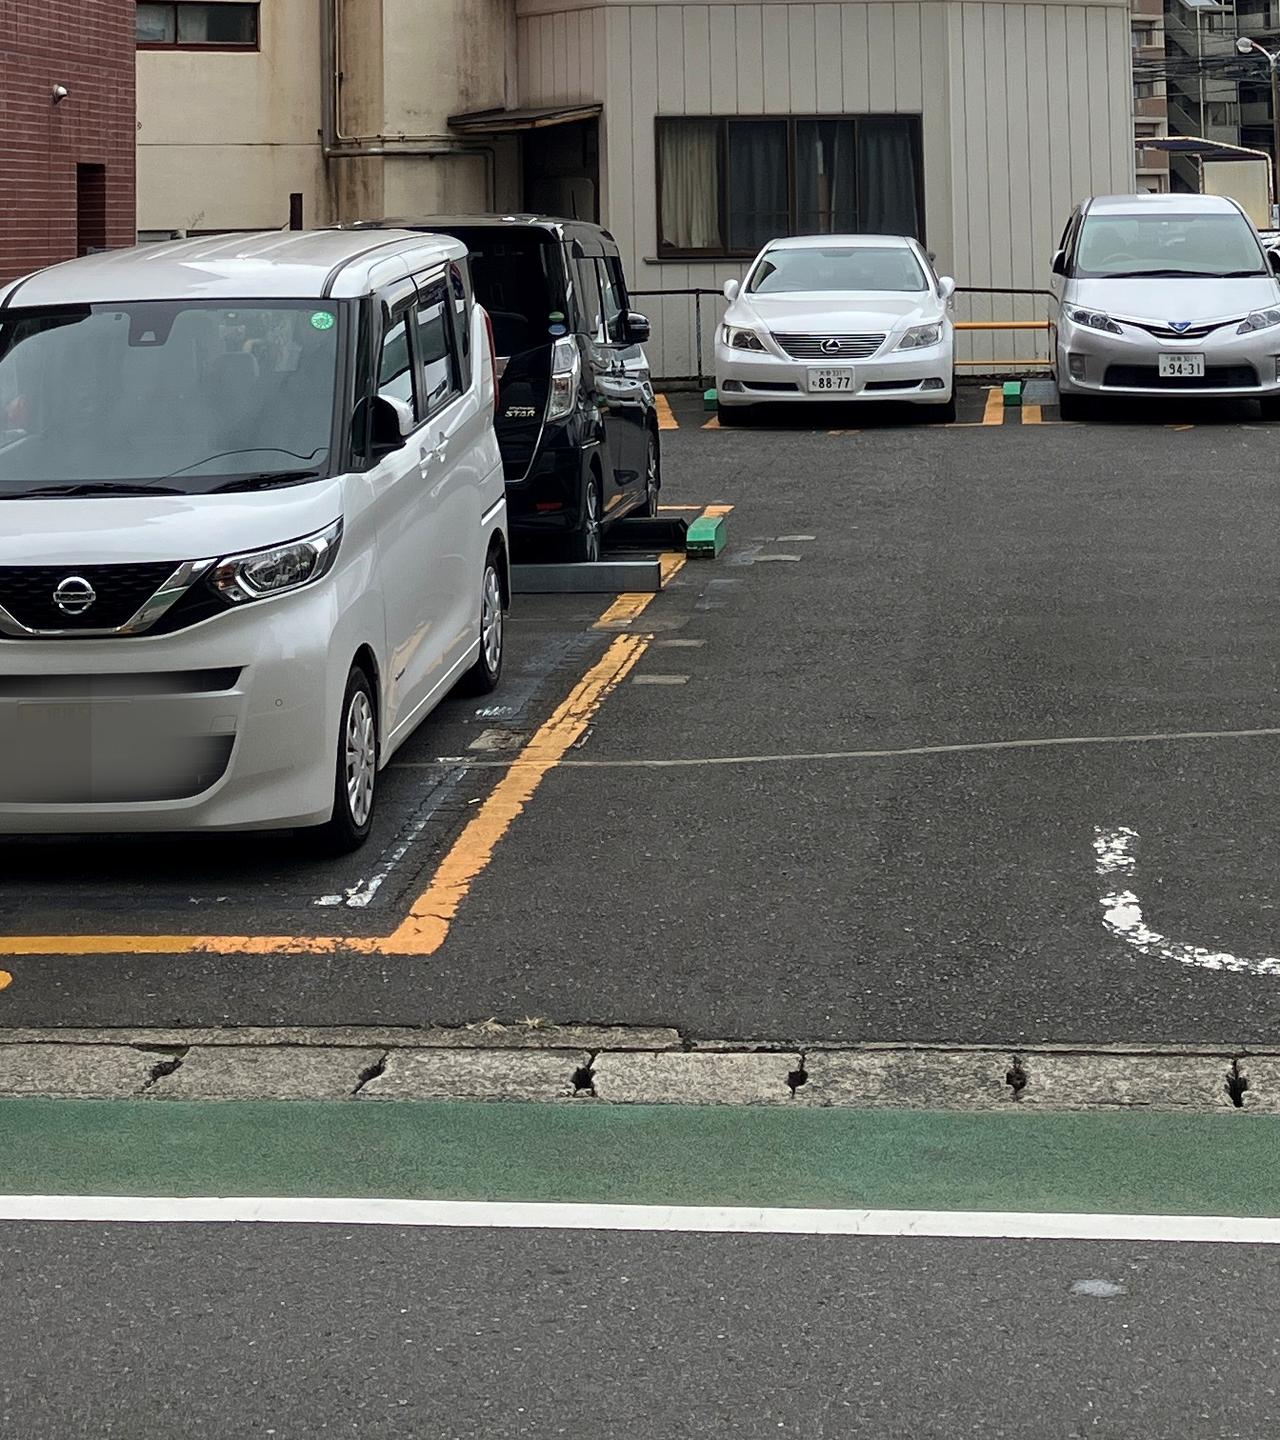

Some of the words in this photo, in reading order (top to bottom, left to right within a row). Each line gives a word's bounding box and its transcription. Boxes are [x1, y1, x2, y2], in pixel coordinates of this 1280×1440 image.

[1169, 363, 1201, 375] 94-31
[818, 377, 850, 389] 88-77
[504, 410, 536, 418] STAR
